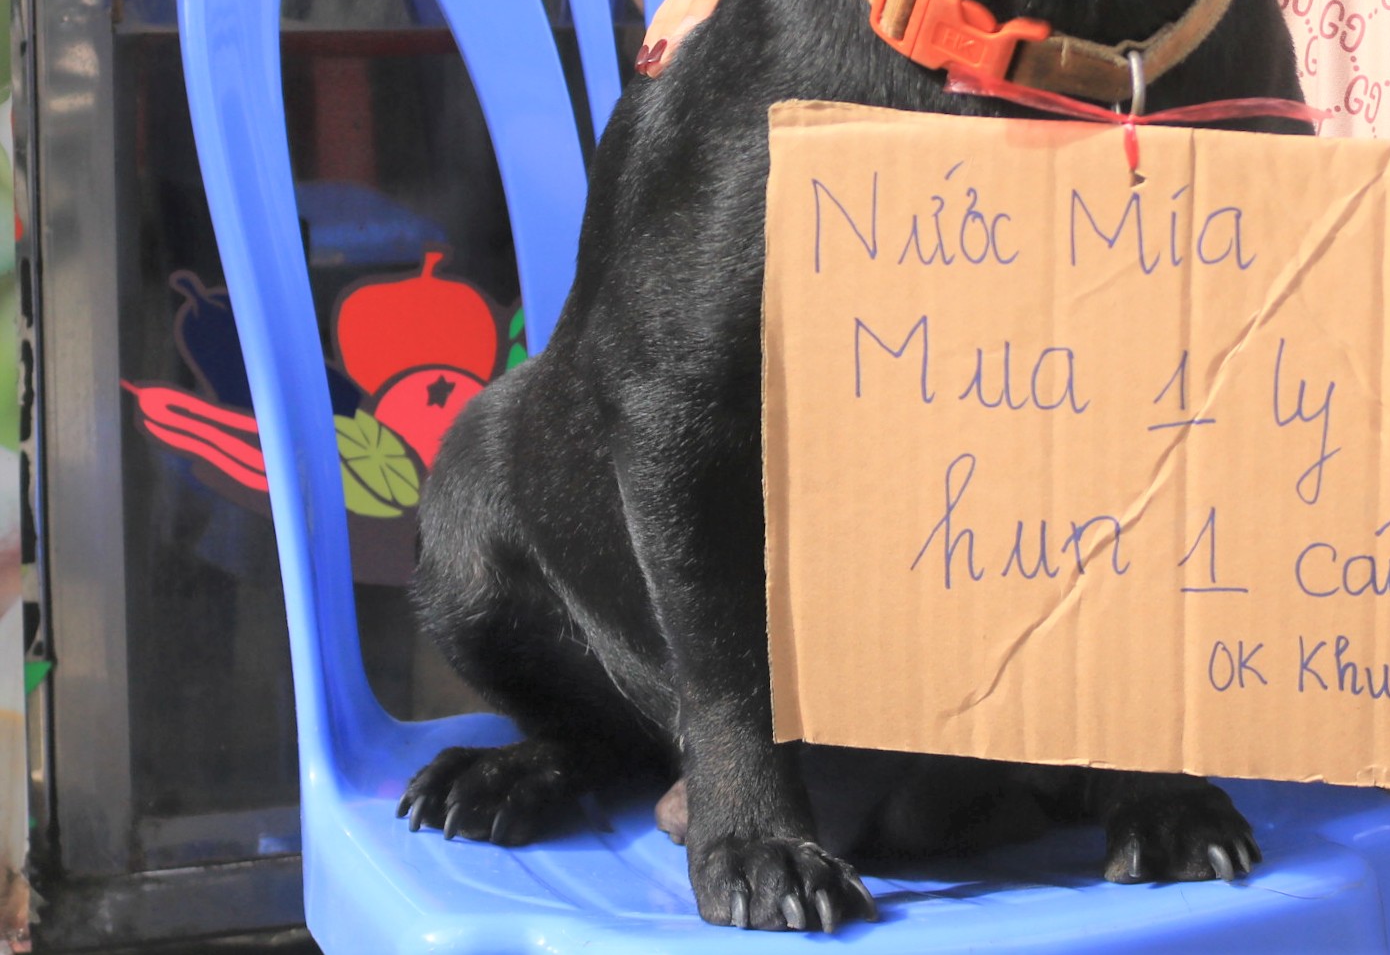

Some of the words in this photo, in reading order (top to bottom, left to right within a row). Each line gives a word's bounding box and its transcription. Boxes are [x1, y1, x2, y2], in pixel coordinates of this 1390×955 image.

[812, 163, 1019, 273] Nước
[1071, 187, 1256, 276] Mía
[855, 315, 1088, 415] Mua
[1151, 350, 1203, 423] 1
[1274, 338, 1340, 506] ly
[912, 453, 1130, 591] hun
[1180, 508, 1233, 593] 1
[1208, 641, 1269, 693] OK
